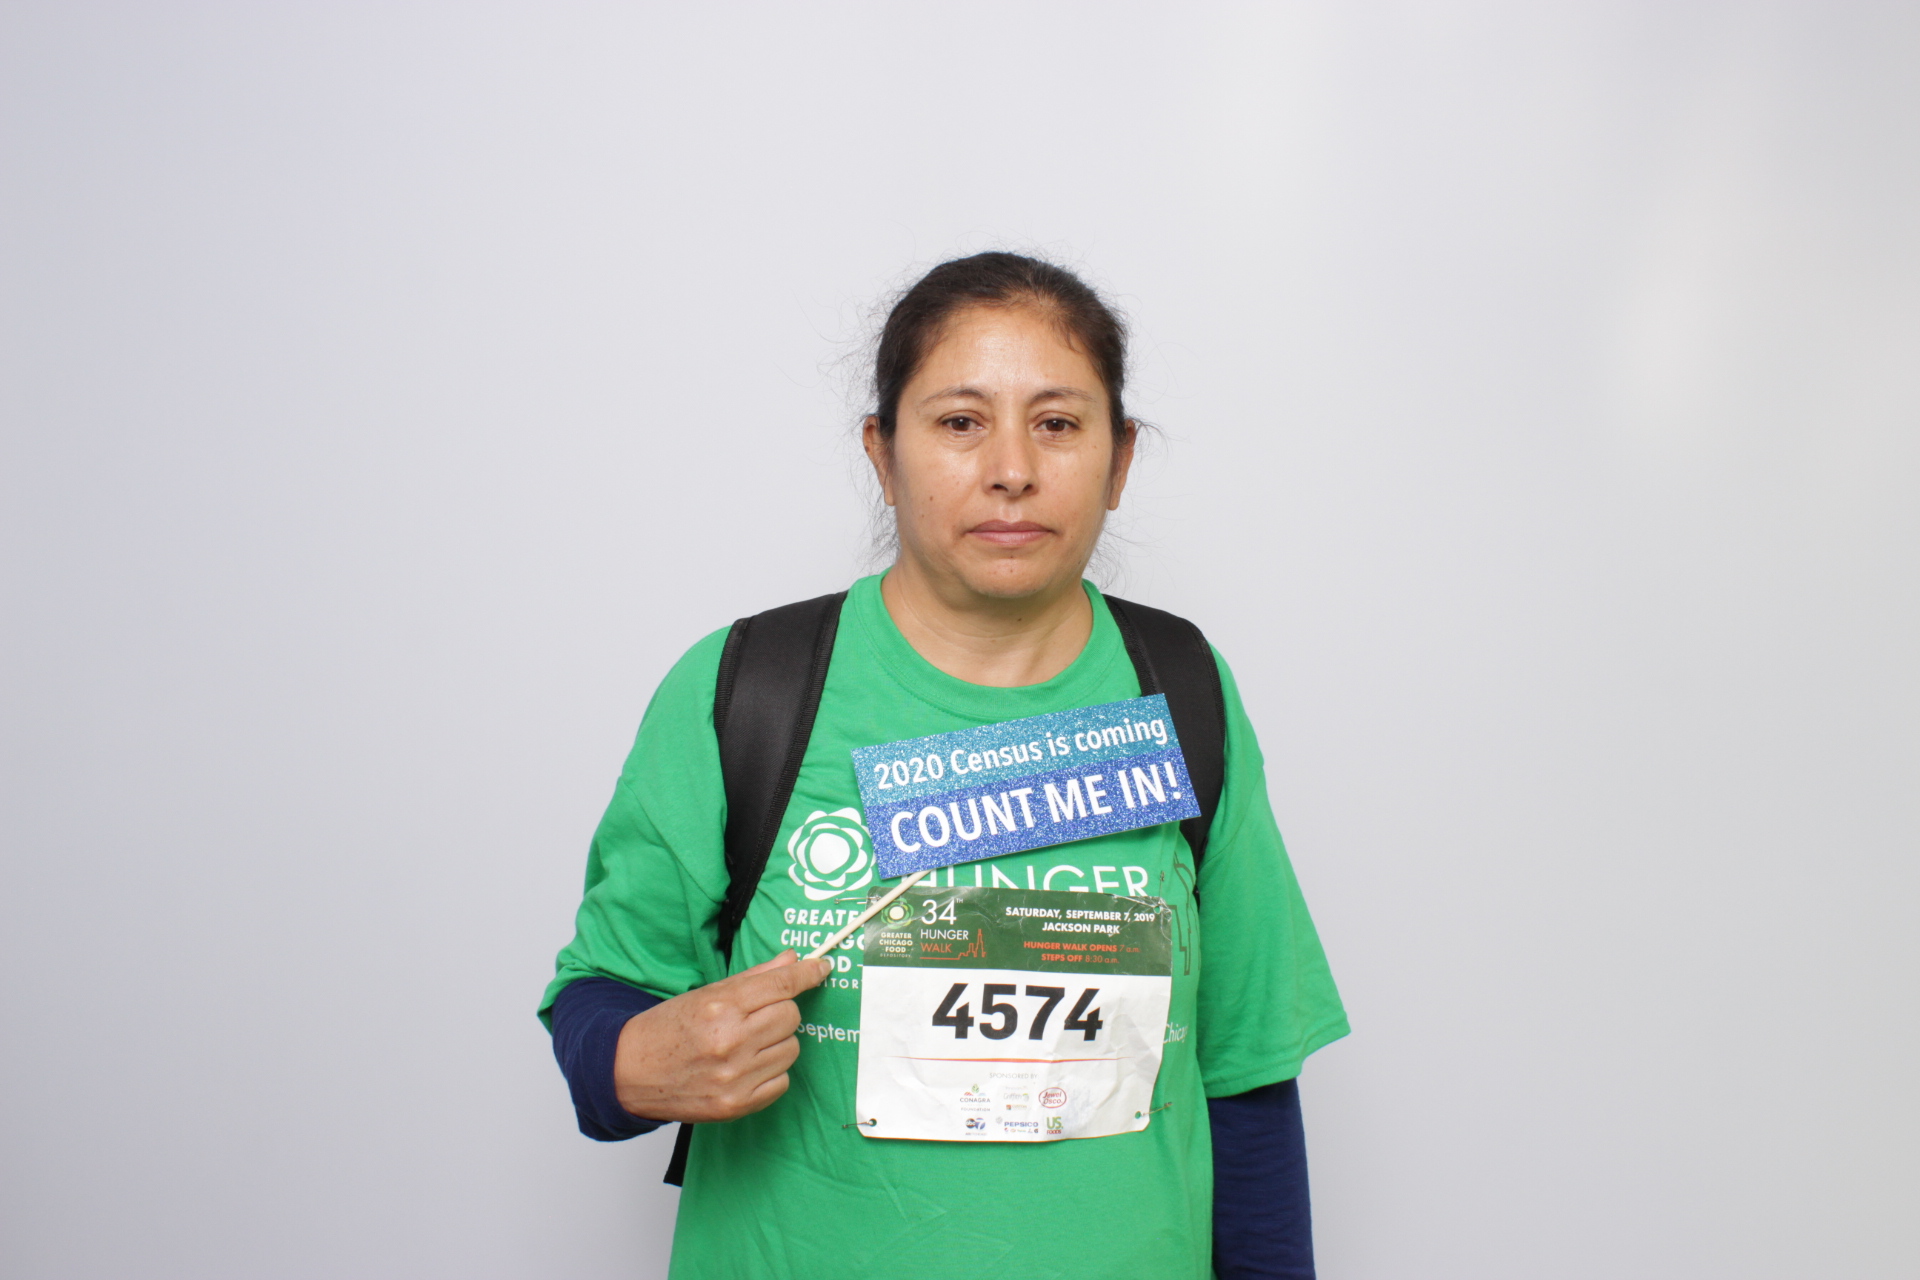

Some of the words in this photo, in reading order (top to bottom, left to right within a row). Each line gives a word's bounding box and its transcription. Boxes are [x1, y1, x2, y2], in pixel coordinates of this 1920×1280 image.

[874, 753, 944, 790] 2020
[951, 739, 1043, 775] Census
[1049, 731, 1071, 756] is
[1075, 717, 1168, 751] coming
[890, 787, 1037, 853] COUNT
[1044, 774, 1113, 824] ME
[1118, 761, 1182, 809] IN!
[784, 907, 864, 928] GREATE
[1005, 906, 1063, 920] SATURDAY,
[1066, 909, 1122, 921] SEPTEMBER
[1123, 912, 1132, 923] 7,
[1133, 912, 1156, 923] 2019
[1042, 922, 1092, 933] JACKSON
[1093, 923, 1121, 934] PARK
[880, 931, 912, 940] GREATER
[920, 928, 969, 941] HUNGER
[920, 943, 953, 953] WALK
[1023, 941, 1061, 950] HUNGER
[1062, 942, 1088, 951] WALK
[1089, 944, 1118, 952] OPENS
[1119, 944, 1125, 952] 7
[1041, 953, 1066, 962] STEPS
[1066, 954, 1083, 962] OFF
[1085, 955, 1103, 963] 8:30
[931, 982, 1104, 1042] 4574
[1042, 1091, 1063, 1099] Jewel
